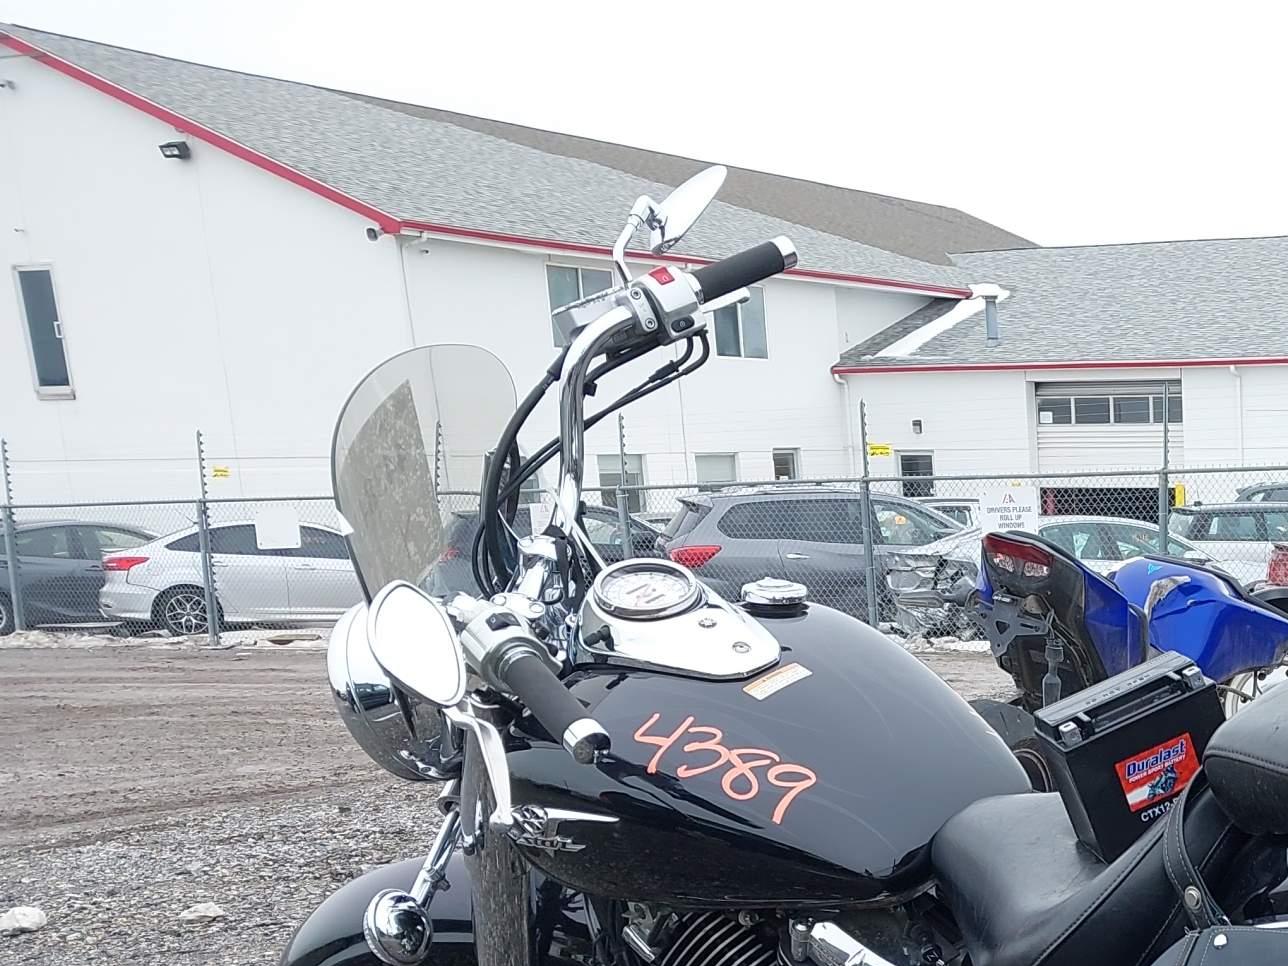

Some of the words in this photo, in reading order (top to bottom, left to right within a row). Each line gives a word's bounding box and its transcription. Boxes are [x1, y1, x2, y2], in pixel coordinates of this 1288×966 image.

[986, 506, 1012, 514] DRIVERS
[634, 713, 817, 825] 4389
[1126, 739, 1186, 779] Duralast
